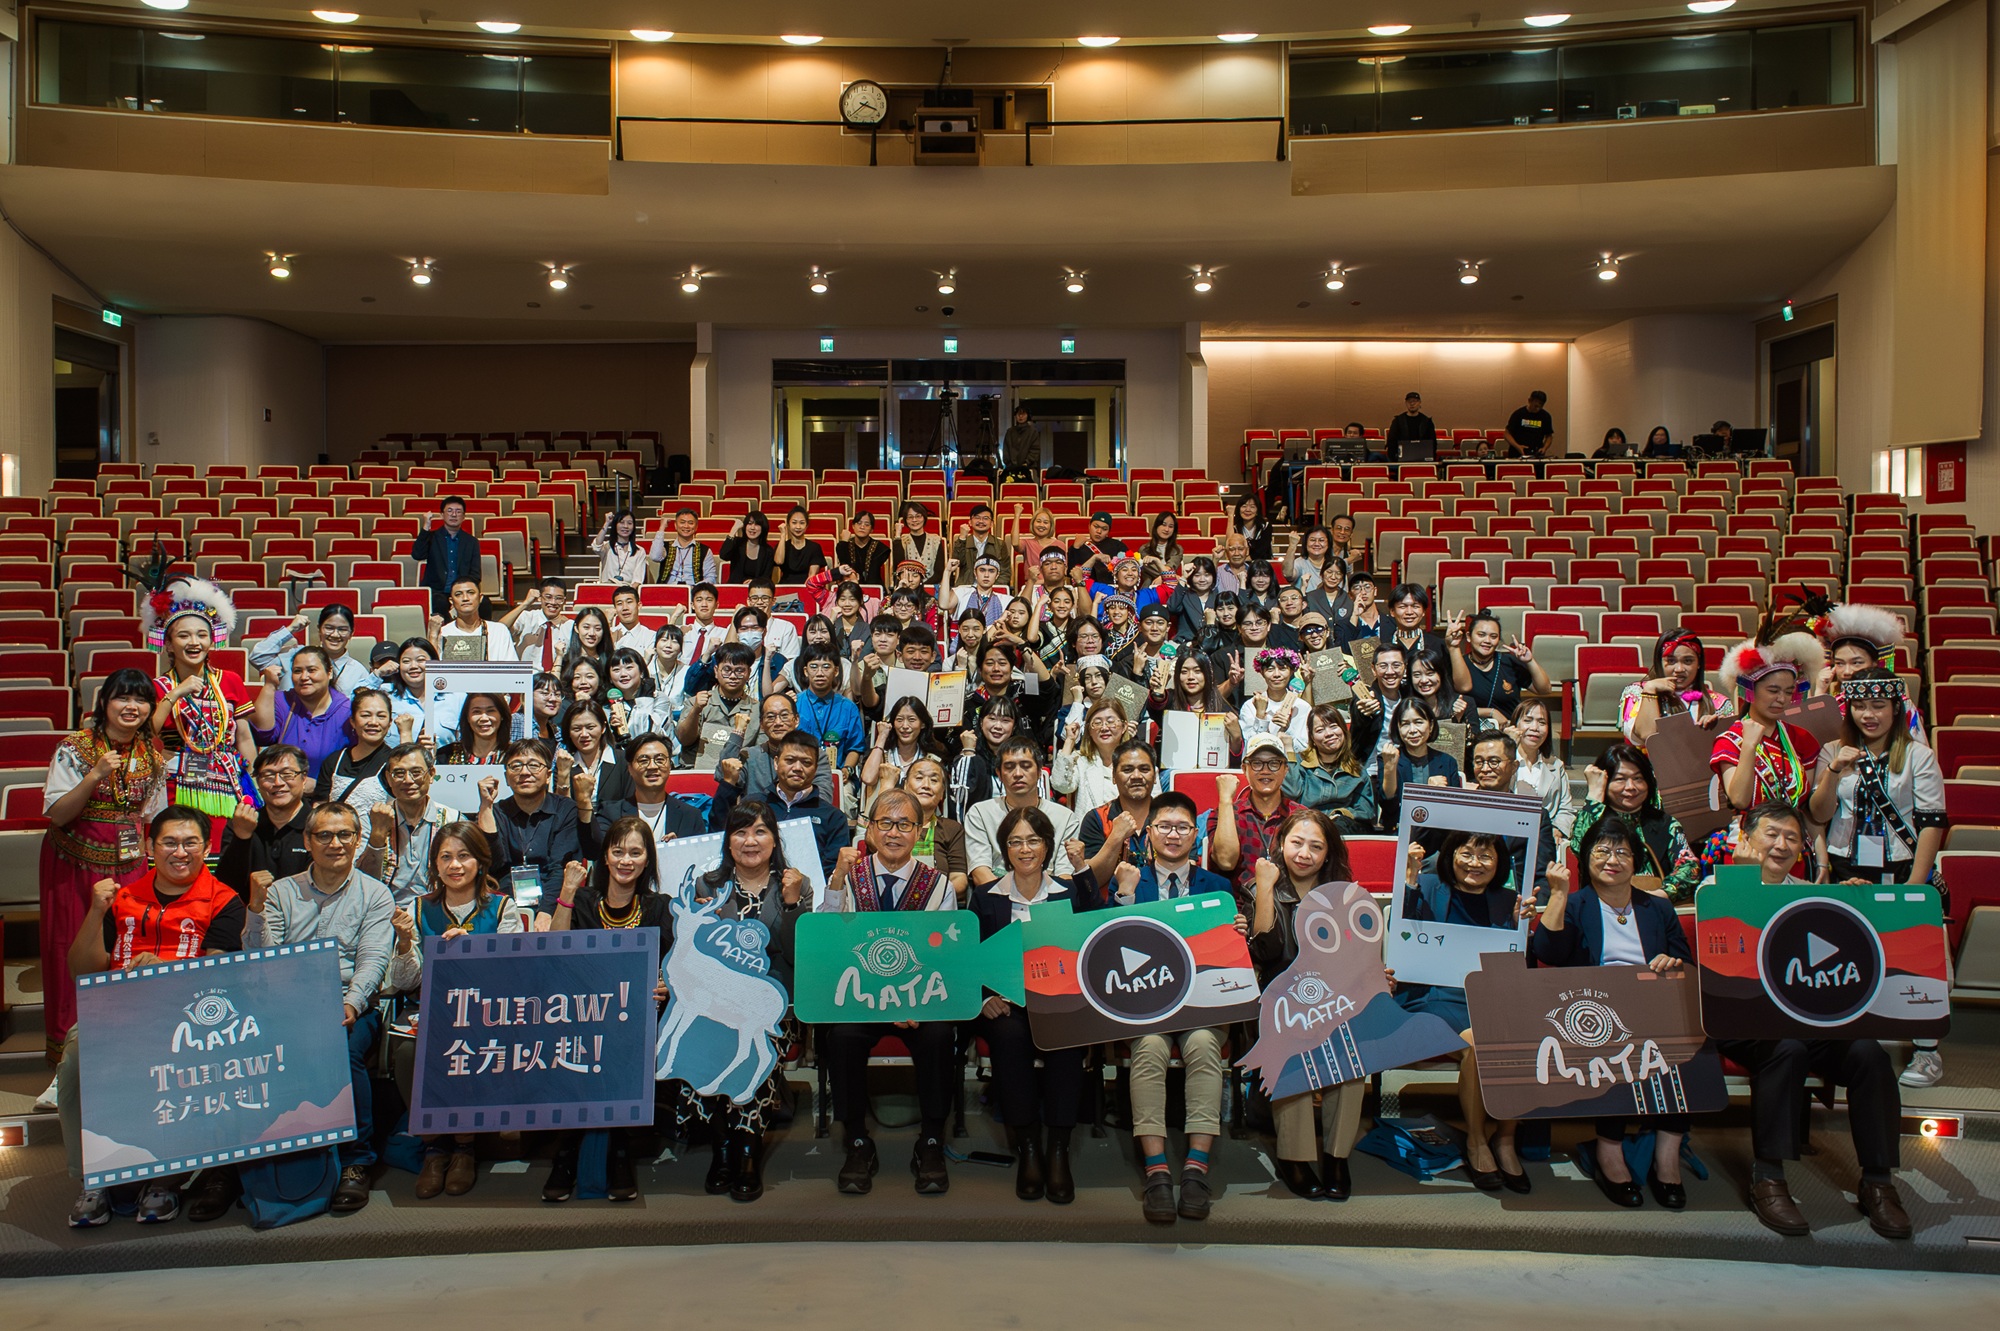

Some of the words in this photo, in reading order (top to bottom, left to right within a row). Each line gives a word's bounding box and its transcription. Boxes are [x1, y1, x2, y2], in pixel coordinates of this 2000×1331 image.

[706, 923, 767, 973] MATA
[834, 966, 949, 1011] MATA
[1105, 964, 1175, 995] MATA
[1785, 957, 1861, 989] MATA
[447, 981, 630, 1028] Tunaw!
[1274, 994, 1356, 1034] MATA
[171, 1015, 260, 1053] MATA
[150, 1044, 285, 1092] Tunaw!
[1536, 1035, 1669, 1088] MATA
[1920, 1119, 1938, 1138] C
